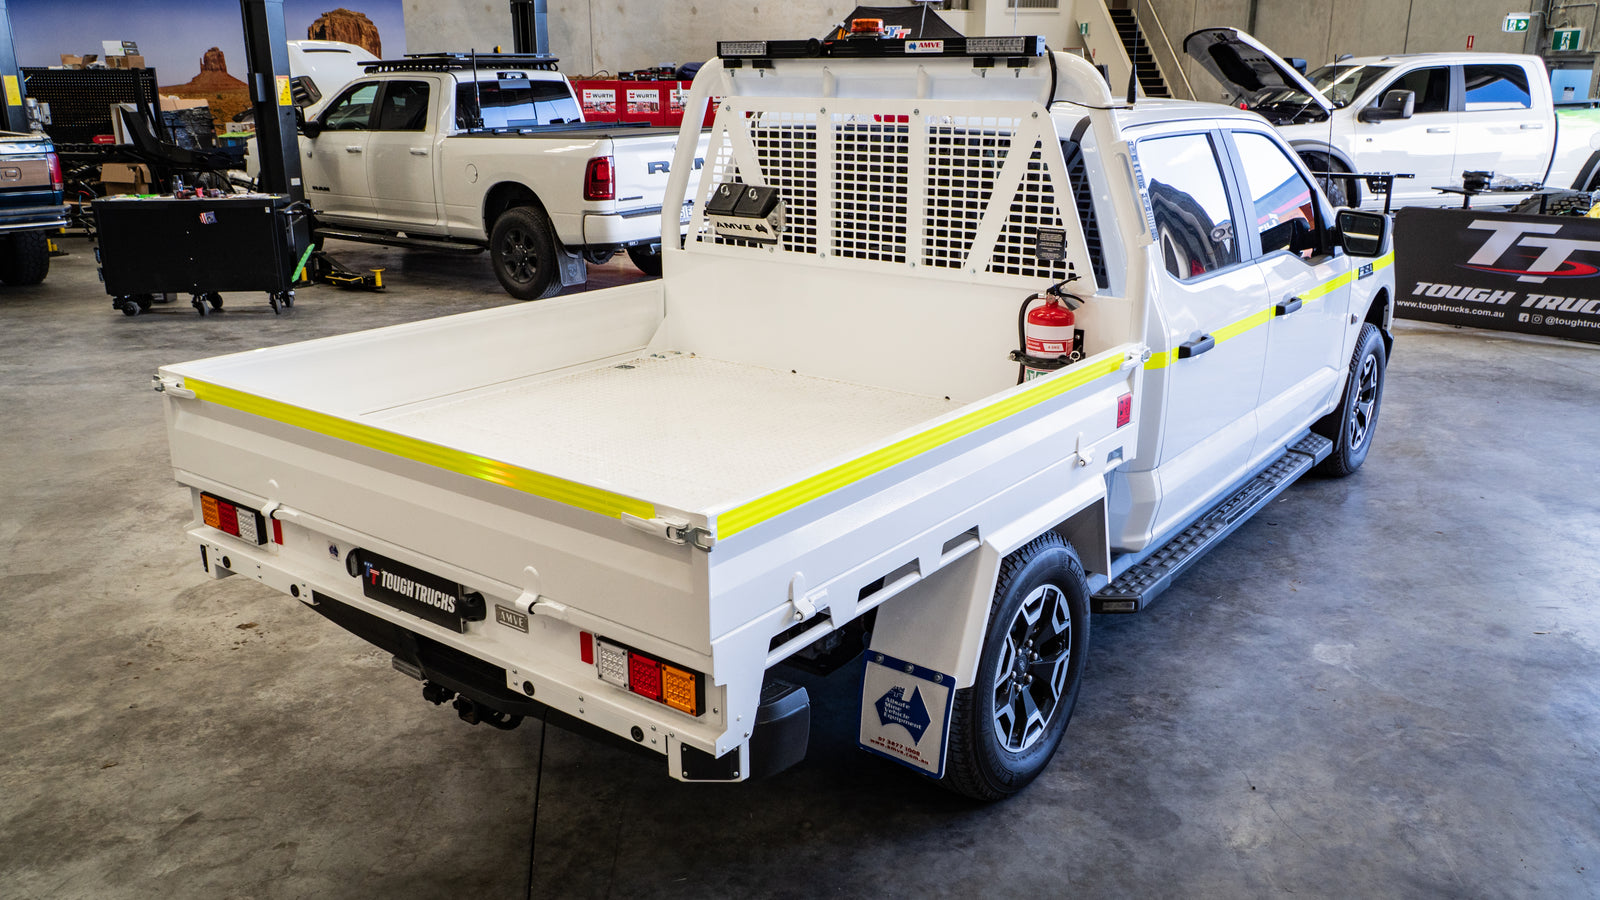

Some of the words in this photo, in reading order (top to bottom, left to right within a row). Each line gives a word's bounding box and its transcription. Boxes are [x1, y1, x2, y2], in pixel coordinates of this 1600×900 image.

[716, 221, 752, 231] AMVE
[1412, 282, 1516, 305] TOUGH
[1520, 293, 1600, 315] TRUC
[1396, 300, 1505, 318] www.toughtrucks.com.au
[381, 570, 415, 598] TOUGH
[415, 582, 457, 613] TRUCKS
[500, 611, 524, 628] AMVE
[884, 701, 902, 712] Mine
[885, 697, 911, 709] Allsafe
[883, 712, 922, 730] Equipment
[884, 707, 910, 720] Vehicle
